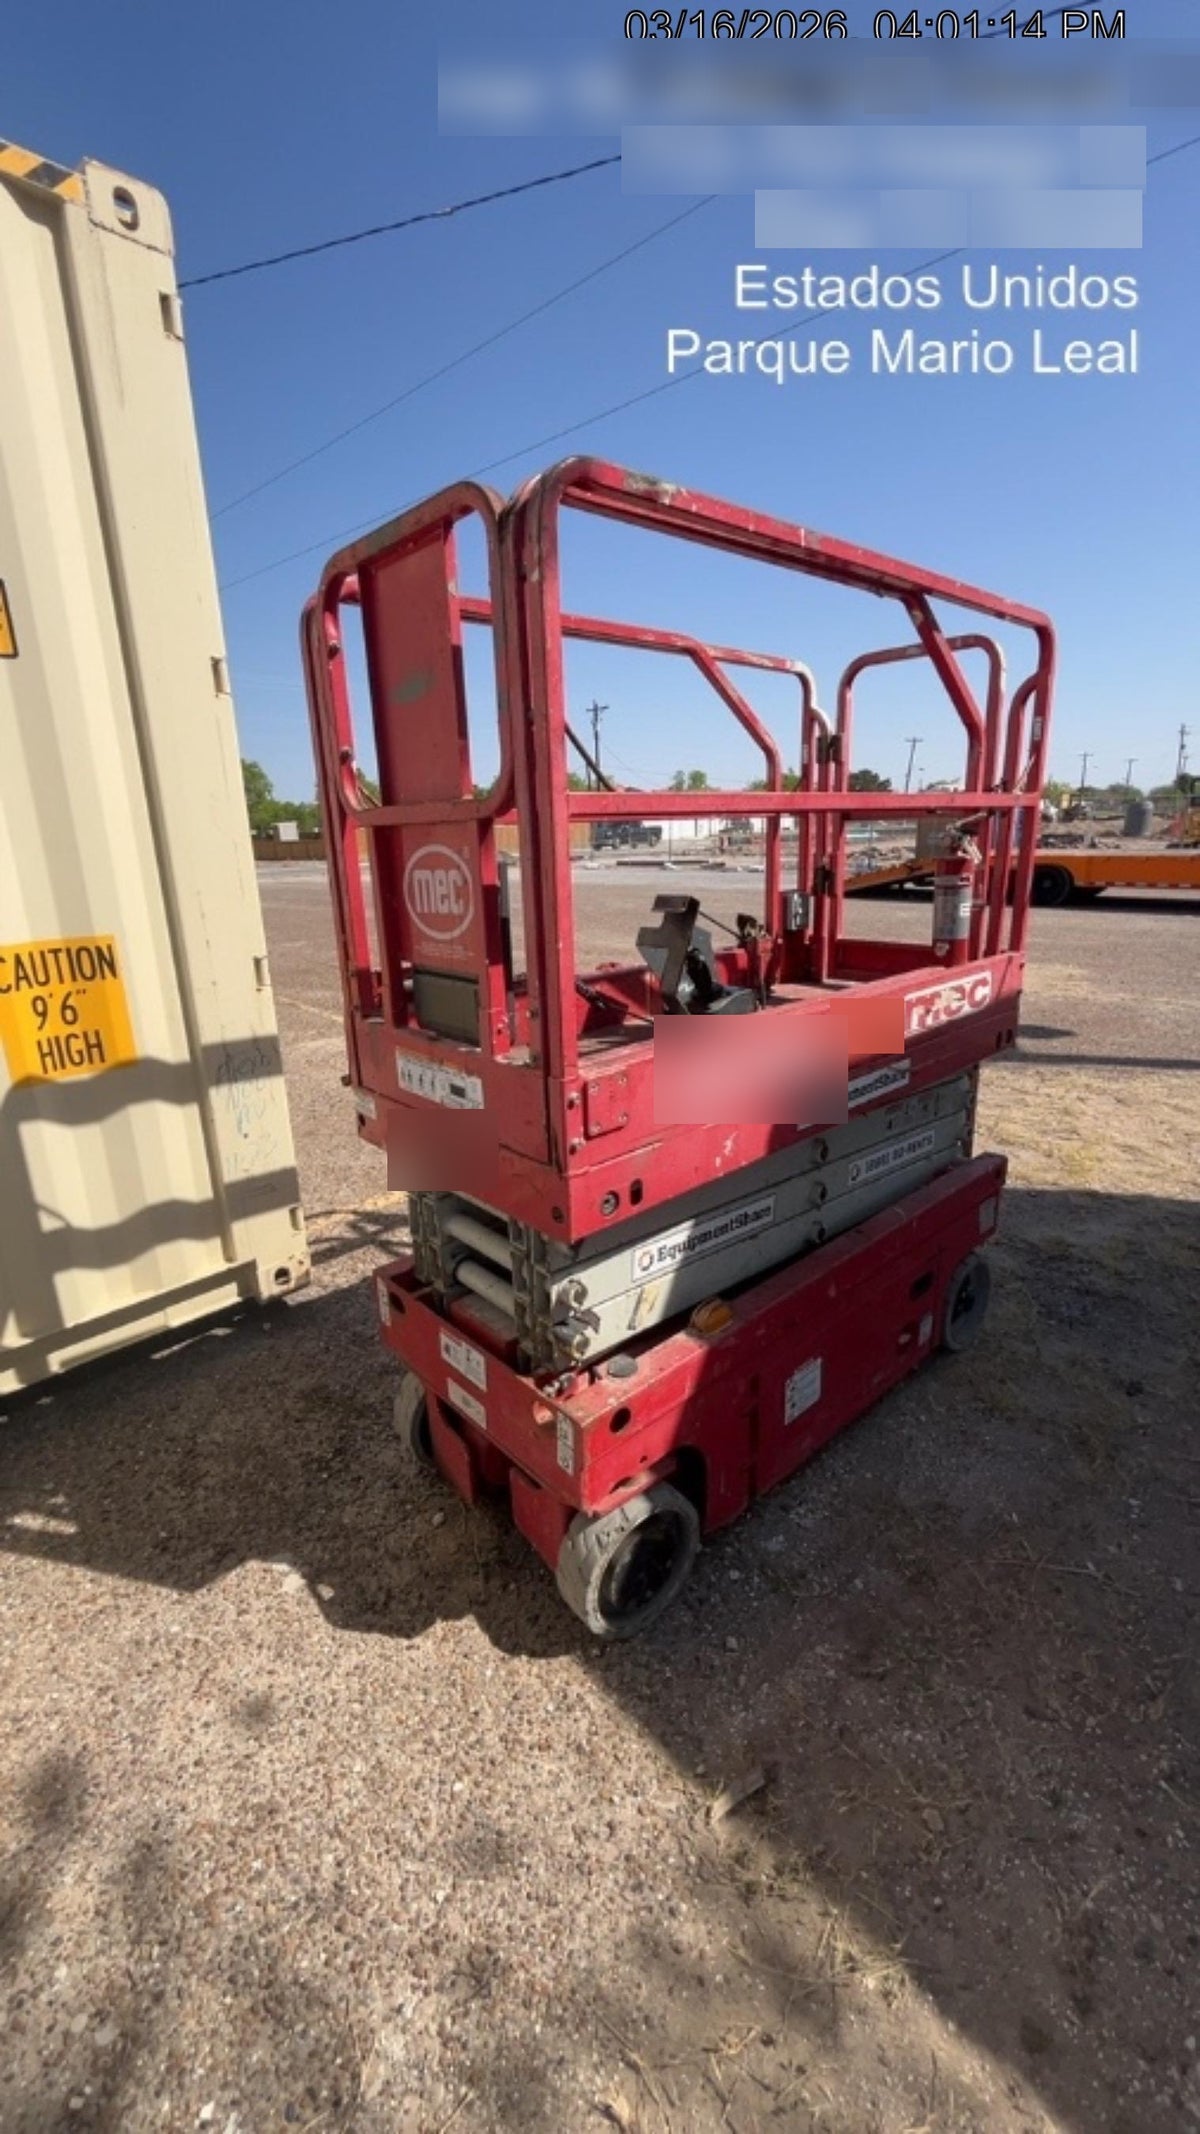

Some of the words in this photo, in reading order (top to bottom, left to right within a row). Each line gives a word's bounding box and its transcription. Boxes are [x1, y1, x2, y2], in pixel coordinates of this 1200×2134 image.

[413, 869, 464, 914] mec
[37, 1029, 105, 1075] HIGH
[656, 1205, 772, 1263] EquipmentShare
